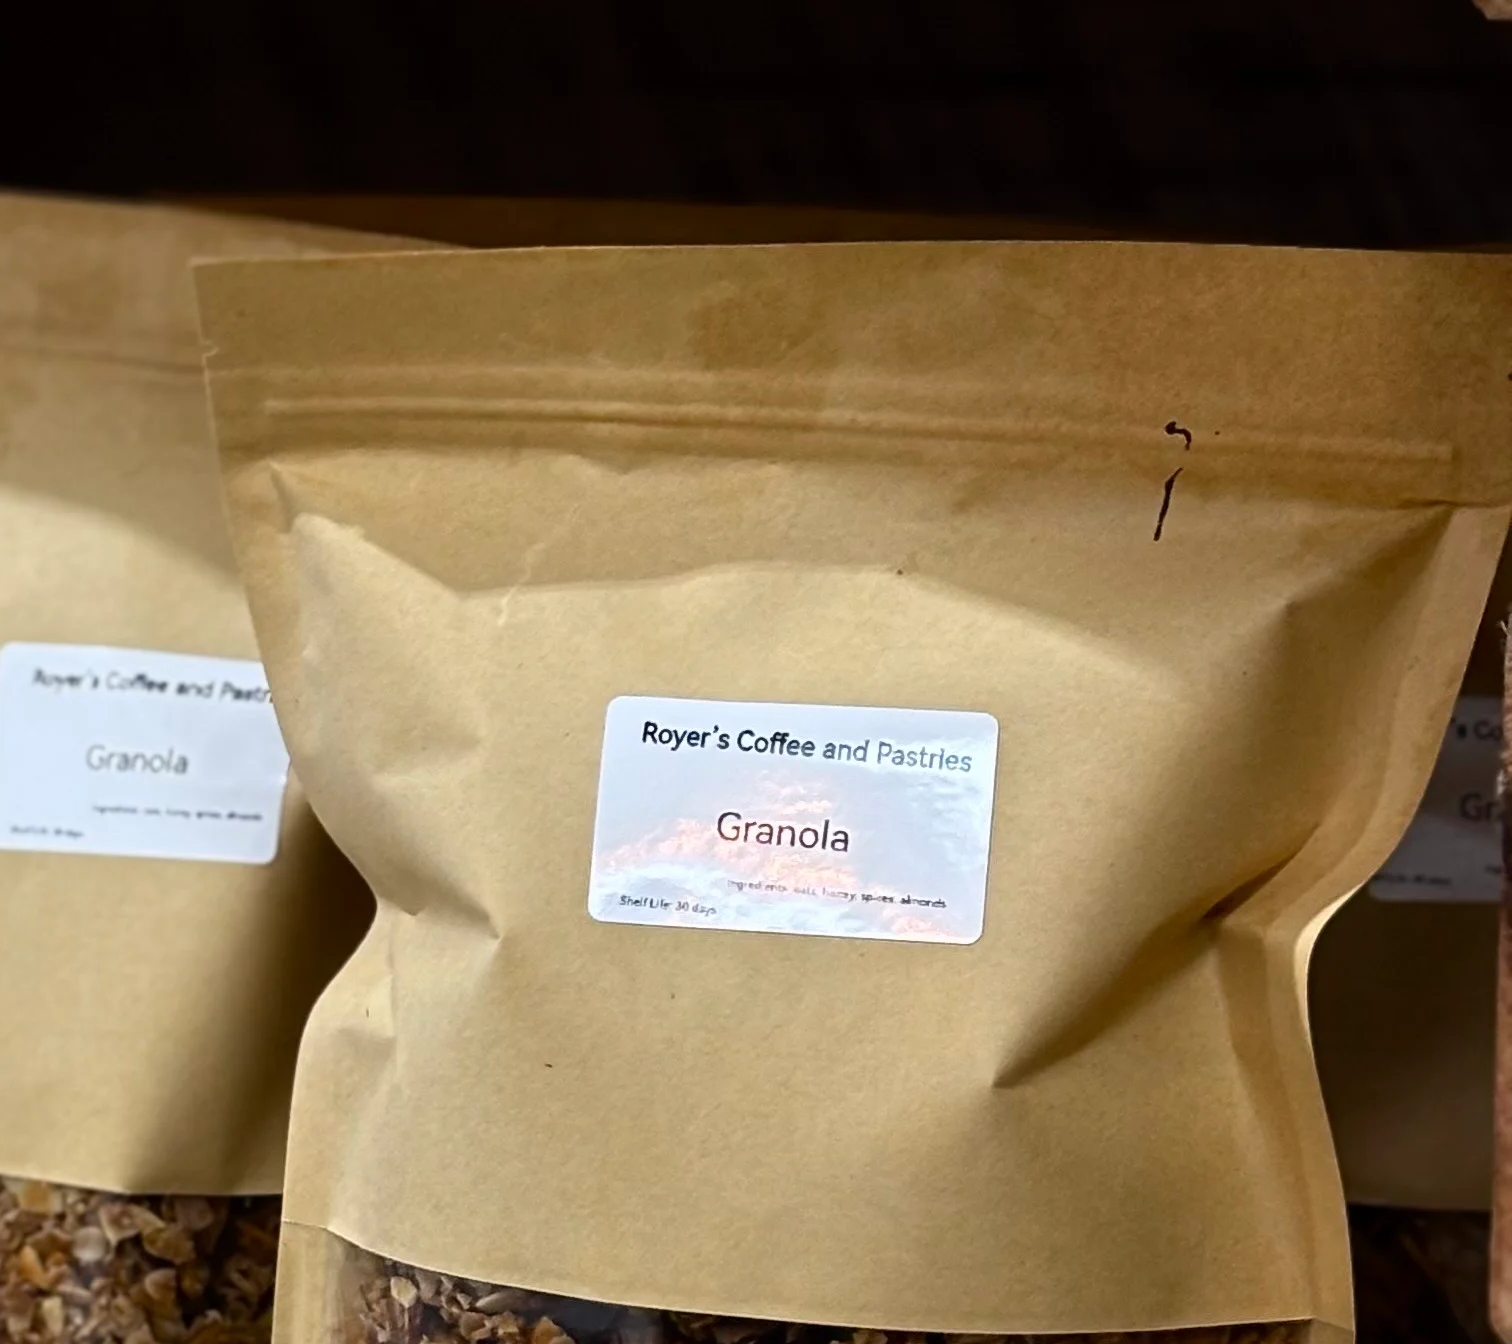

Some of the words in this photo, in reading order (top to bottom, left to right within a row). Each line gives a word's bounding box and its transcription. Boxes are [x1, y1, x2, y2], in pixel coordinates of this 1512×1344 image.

[105, 670, 168, 692] Coffee
[176, 680, 214, 699] and
[219, 680, 273, 703] Pastr
[85, 744, 189, 775] Granola
[642, 720, 730, 751] Royer's
[737, 729, 816, 758] Coffee
[822, 739, 870, 763] and
[876, 741, 973, 772] Pastries
[716, 811, 849, 853] Granola
